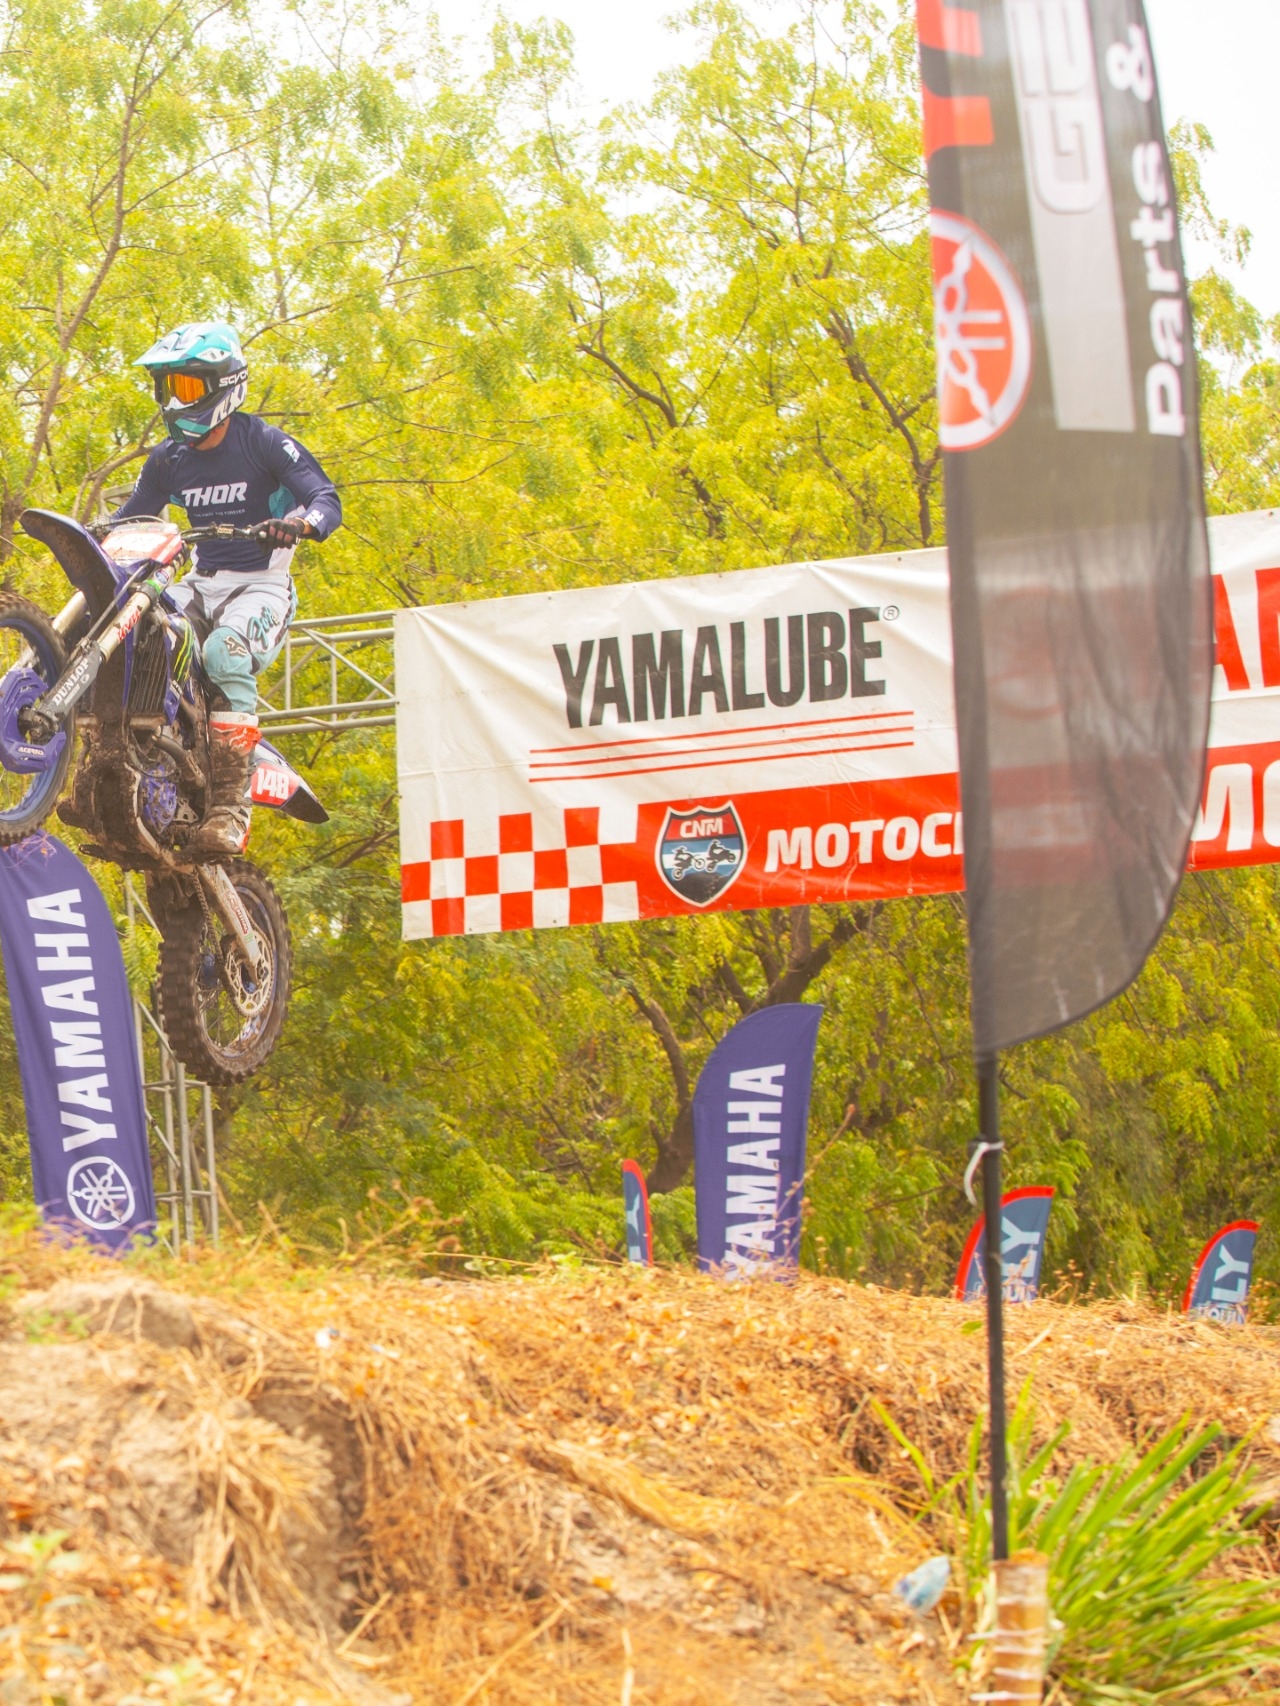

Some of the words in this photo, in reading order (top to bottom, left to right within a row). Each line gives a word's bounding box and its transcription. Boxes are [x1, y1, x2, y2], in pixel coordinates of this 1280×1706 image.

[1130, 142, 1187, 437] Parts
[181, 481, 248, 508] THOR
[52, 656, 89, 707] DUNLOP
[553, 606, 886, 729] YAMALUBE
[256, 767, 290, 801] 148
[764, 811, 965, 873] MOTOC
[26, 888, 118, 1153] YAMAHA
[724, 1064, 786, 1282] YAMAHA
